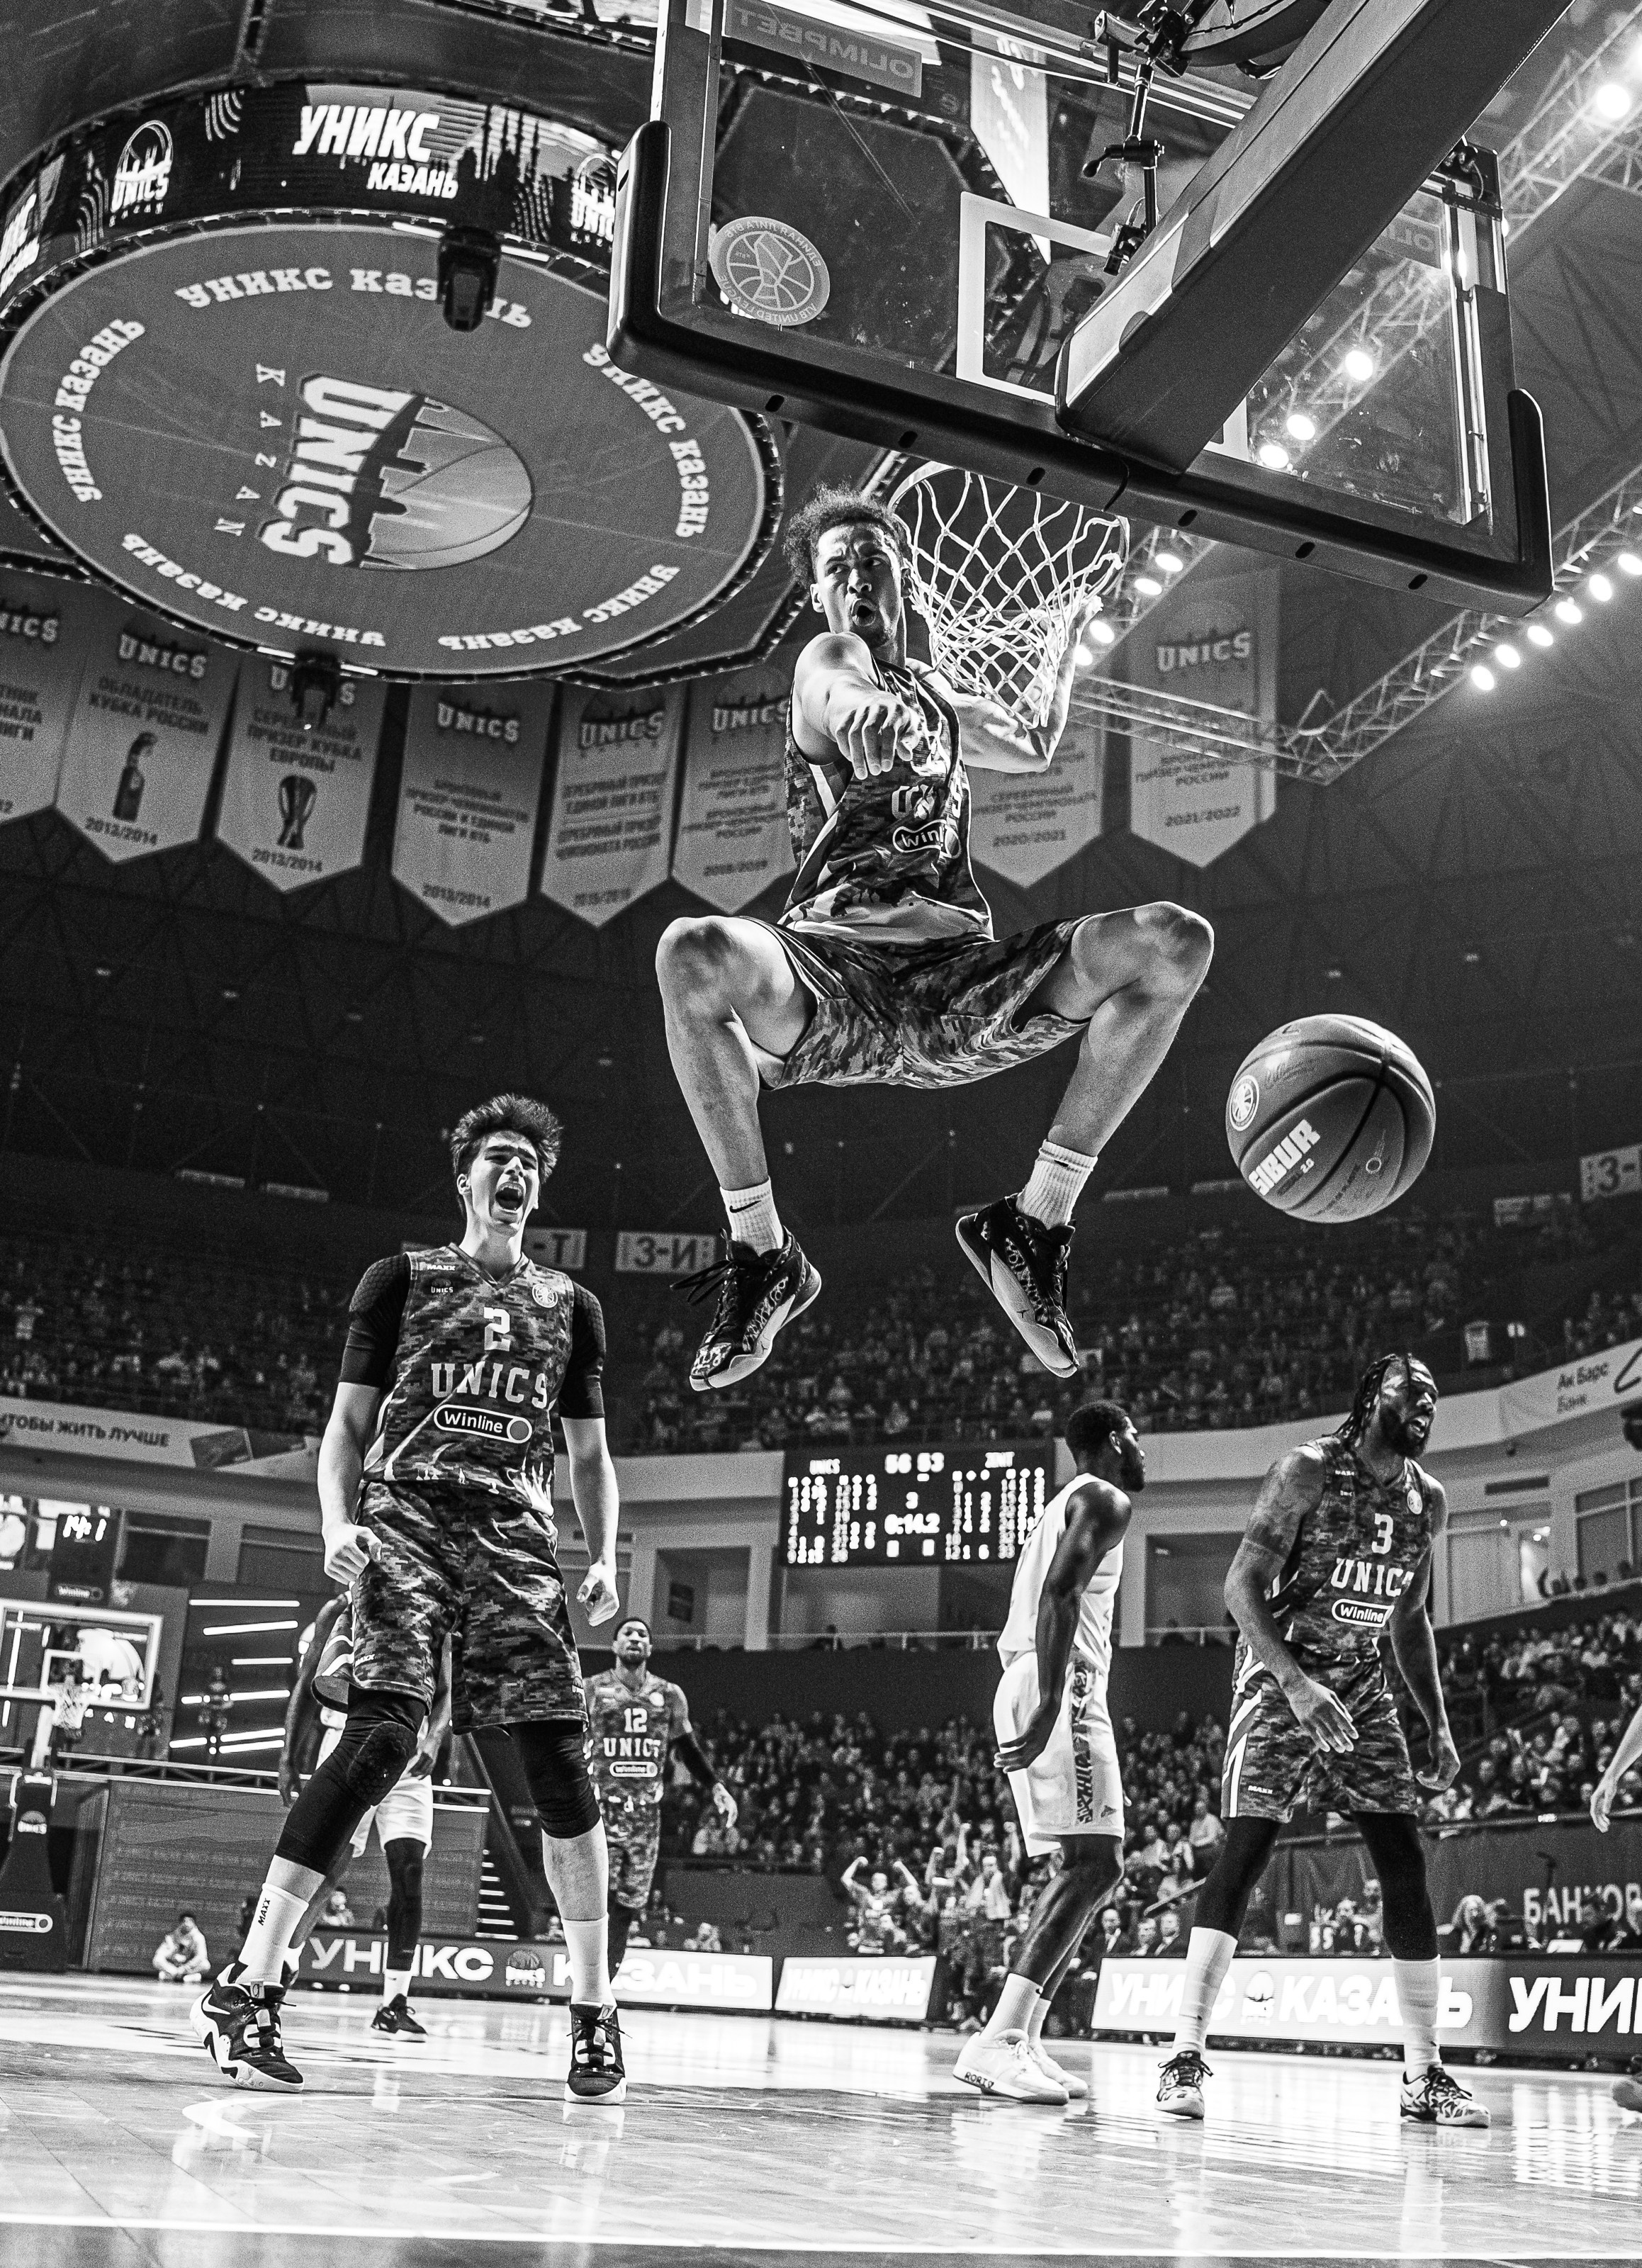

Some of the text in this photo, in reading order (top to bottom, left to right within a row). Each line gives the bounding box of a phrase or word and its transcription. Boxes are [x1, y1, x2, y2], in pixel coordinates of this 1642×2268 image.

[293, 104, 439, 164] УНИКС
[367, 162, 459, 199] КАЗАНЬ
[261, 376, 417, 566] UNICS
[118, 634, 207, 678] UNICS
[1157, 632, 1252, 673] UNICS
[89, 692, 210, 736] КУБКА РОССИИ
[437, 702, 519, 744] UNICS
[580, 709, 665, 749] UNICS
[269, 748, 336, 773] ЕВРОПЫ
[1175, 770, 1230, 787] РОССИИ
[1249, 1119, 1321, 1196] SIBUR
[1300, 1157, 1315, 1174] 2.0
[483, 1307, 510, 1351] 2
[431, 1363, 548, 1410] UNICS
[57, 1420, 106, 1439] ЖИТЬ
[108, 1427, 170, 1448] ЛУЧШЕ
[444, 1411, 503, 1433] Winline
[1371, 1512, 1394, 1555] 3
[1340, 1603, 1384, 1623] Winline
[624, 1707, 648, 1733] 12
[257, 1897, 271, 1926] MAXX
[553, 1952, 758, 1998] КЗАНЬ
[853, 1968, 927, 2006] КАЗАНЬ
[1108, 1973, 1237, 2022] УНИС
[1278, 1974, 1474, 2029] КАЗАЬ
